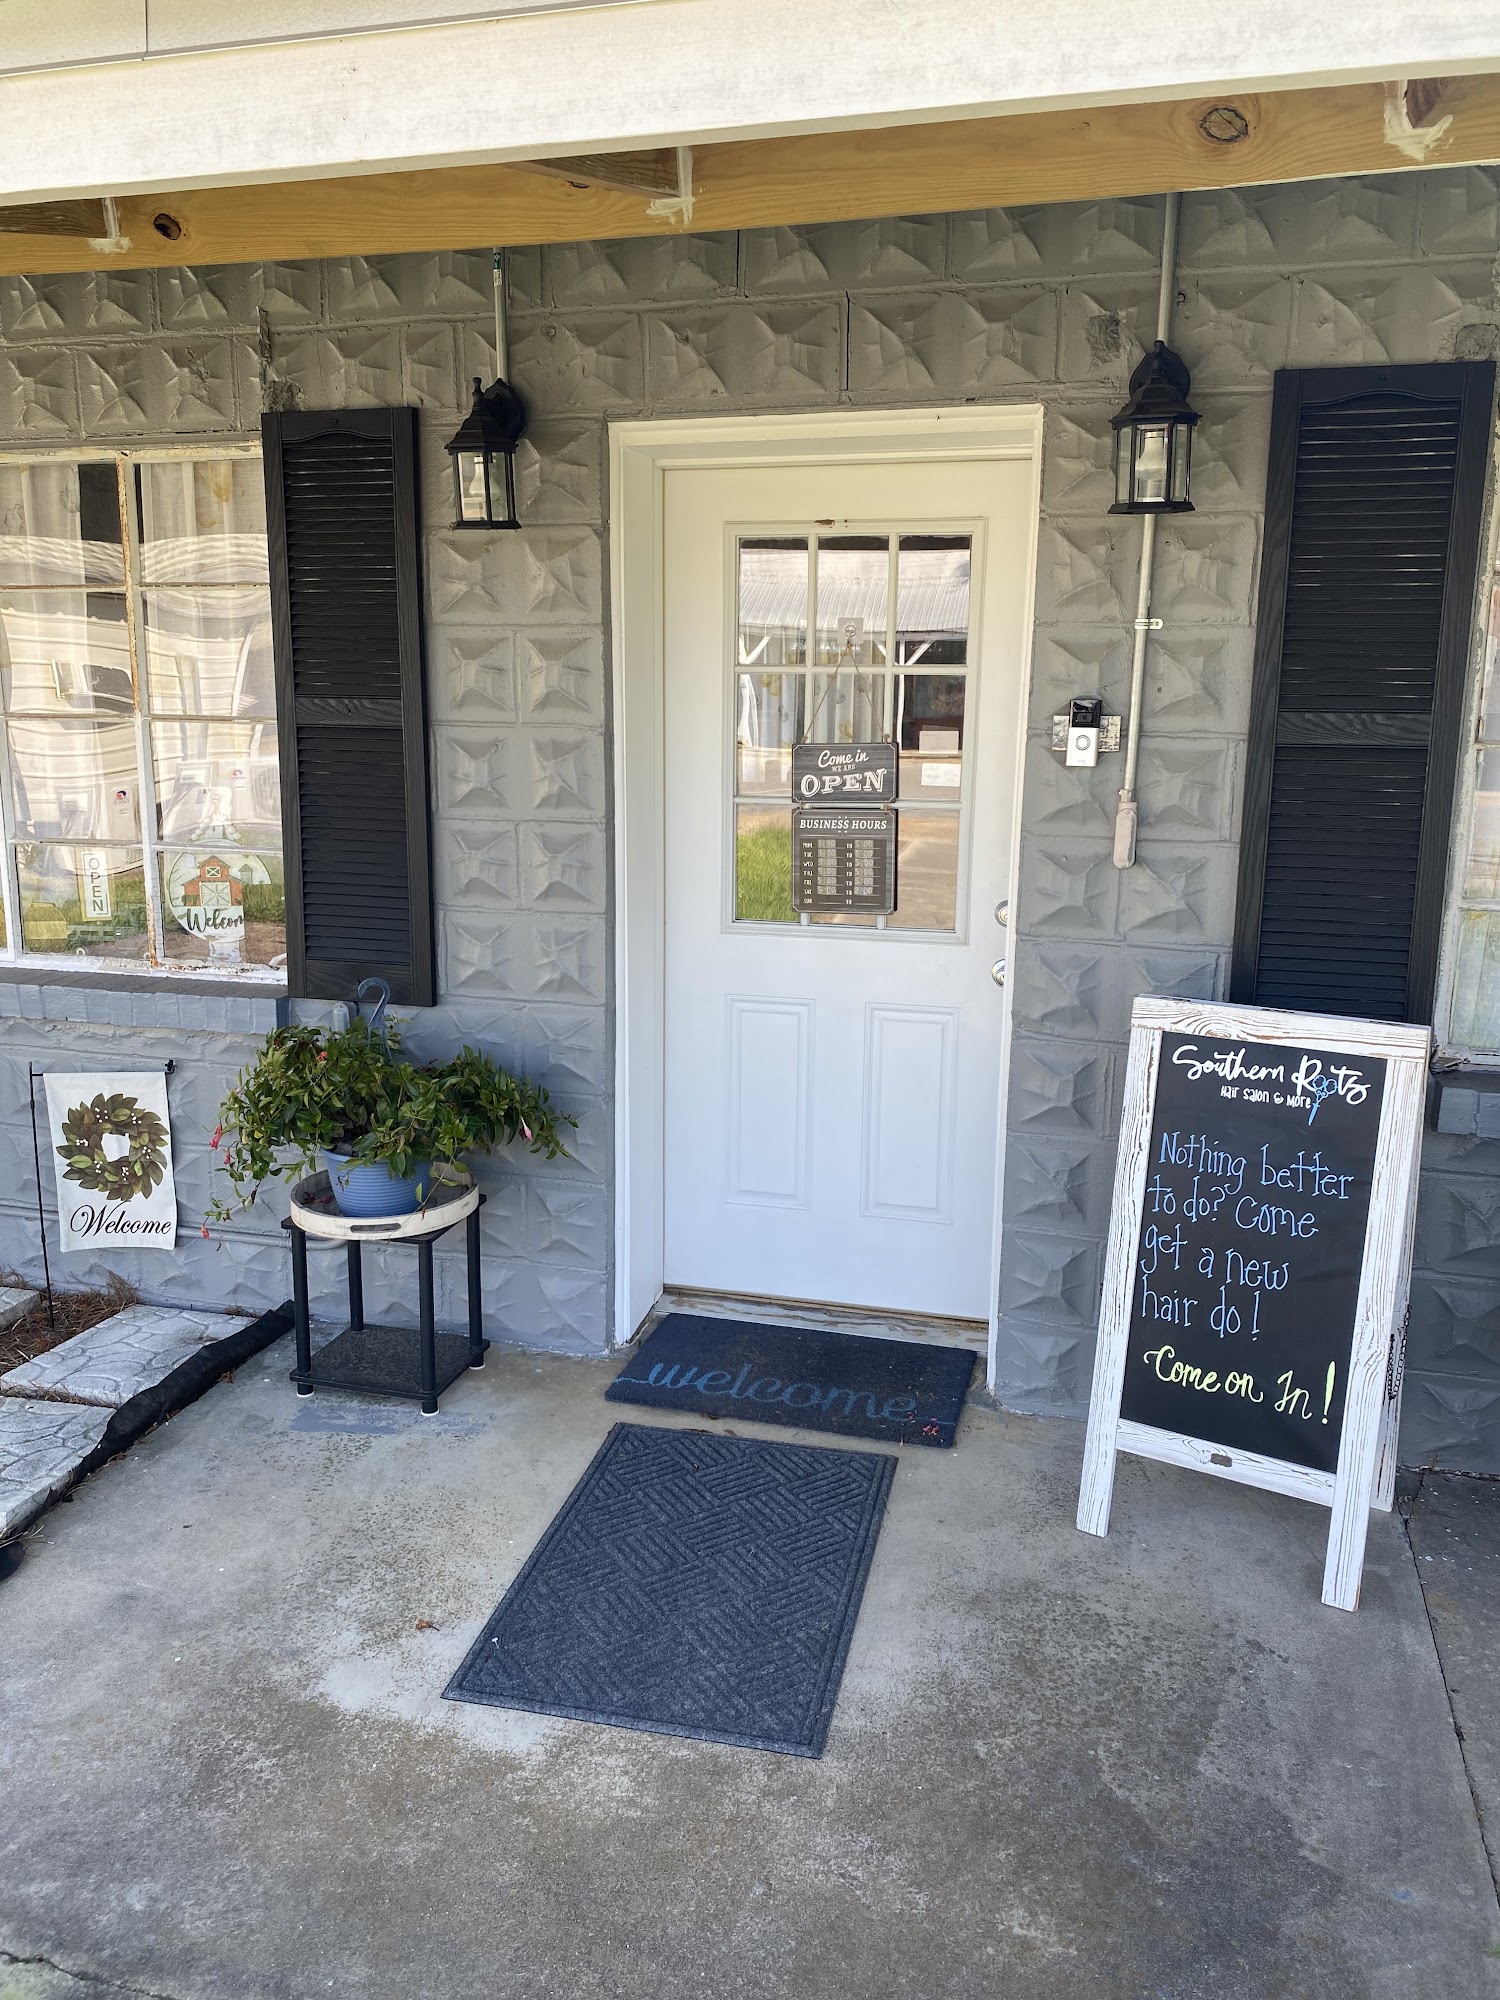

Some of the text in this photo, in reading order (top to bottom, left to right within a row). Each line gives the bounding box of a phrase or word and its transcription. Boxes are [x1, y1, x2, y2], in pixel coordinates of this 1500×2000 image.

[800, 767, 887, 798] OPEN
[817, 748, 869, 768] Come in
[842, 763, 856, 772] ARE
[799, 819, 888, 830] BUSINESS HOURS
[88, 857, 104, 912] OPEN
[186, 907, 245, 933] Welcom
[1172, 1045, 1372, 1106] Southern Roots
[1220, 1085, 1240, 1099] Hair
[1273, 1094, 1285, 1104] &
[1158, 1131, 1355, 1200] Nothing better
[70, 1200, 172, 1238] Welcome
[1146, 1174, 1319, 1238] to do? Come
[1139, 1223, 1290, 1290] get a new
[1141, 1273, 1199, 1327] hair
[613, 1361, 957, 1425] welcome
[1143, 1345, 1222, 1393] Come
[1224, 1371, 1264, 1403] on
